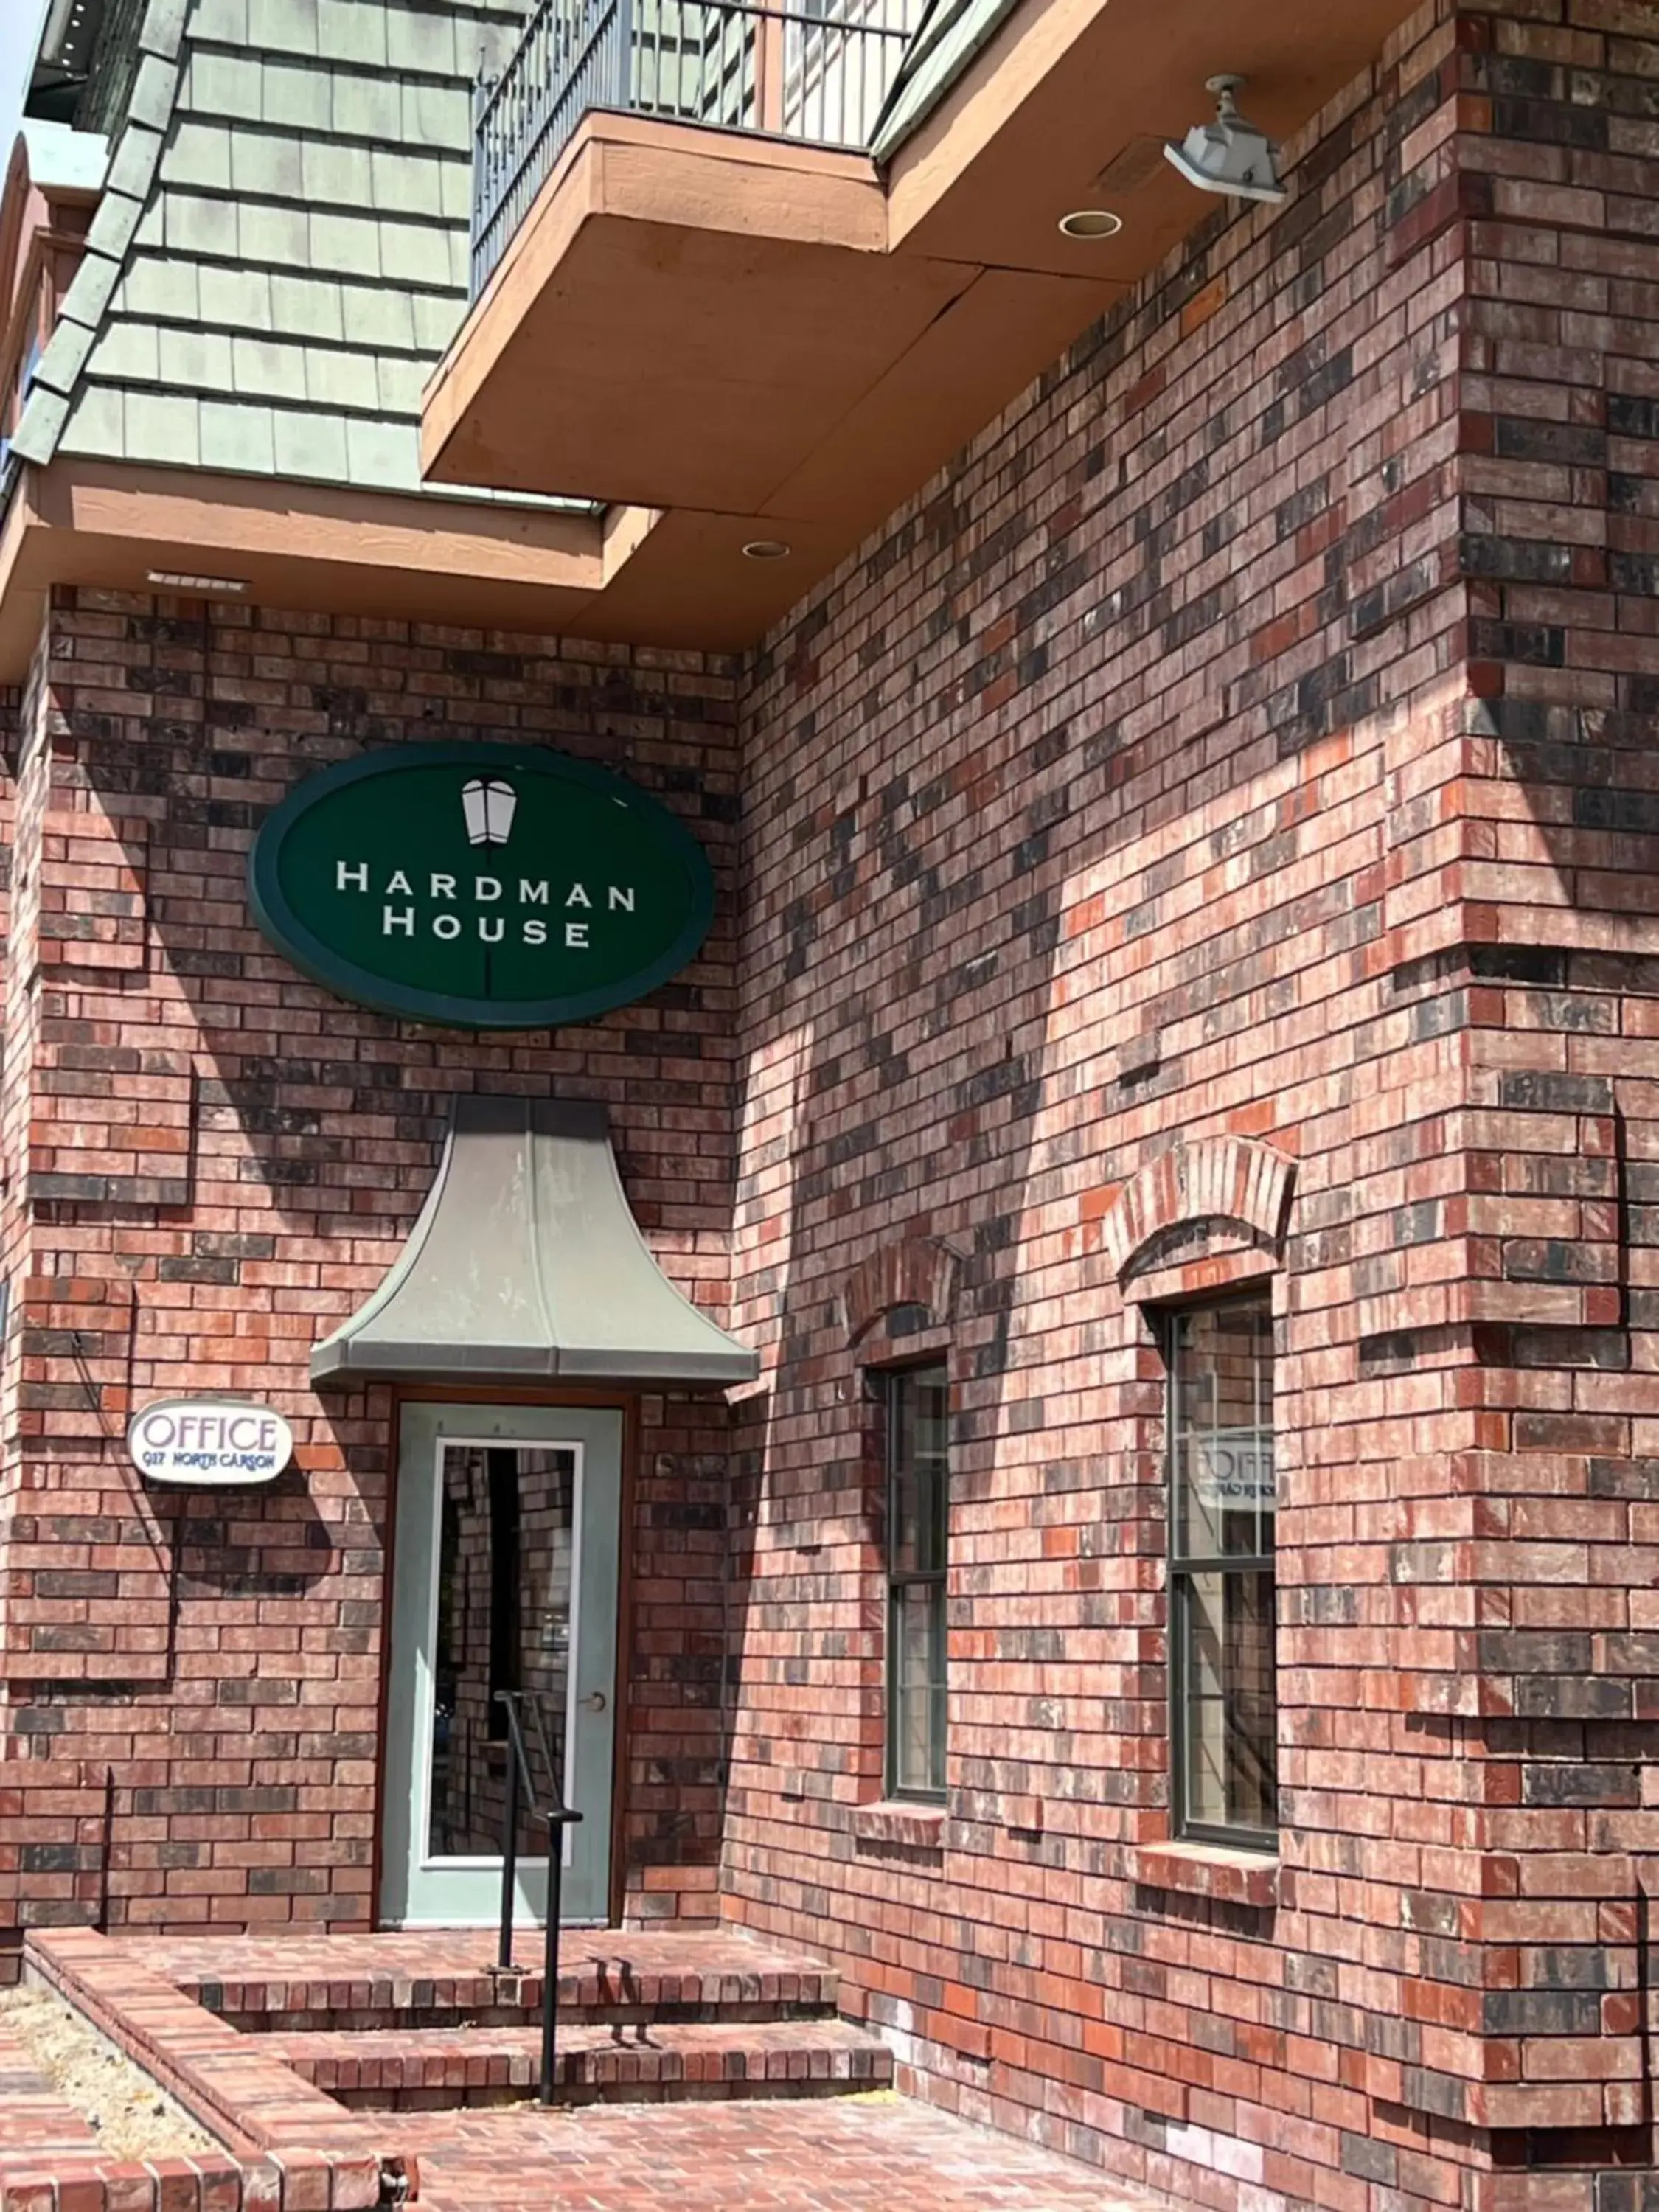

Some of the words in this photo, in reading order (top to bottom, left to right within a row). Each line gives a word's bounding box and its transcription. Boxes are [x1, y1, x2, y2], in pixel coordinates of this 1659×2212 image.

[335, 860, 636, 912] HARDMAN
[382, 905, 590, 948] HOUSE
[142, 1414, 277, 1451] OFFICE
[173, 1451, 217, 1470] NORTH
[220, 1453, 276, 1472] CARSON
